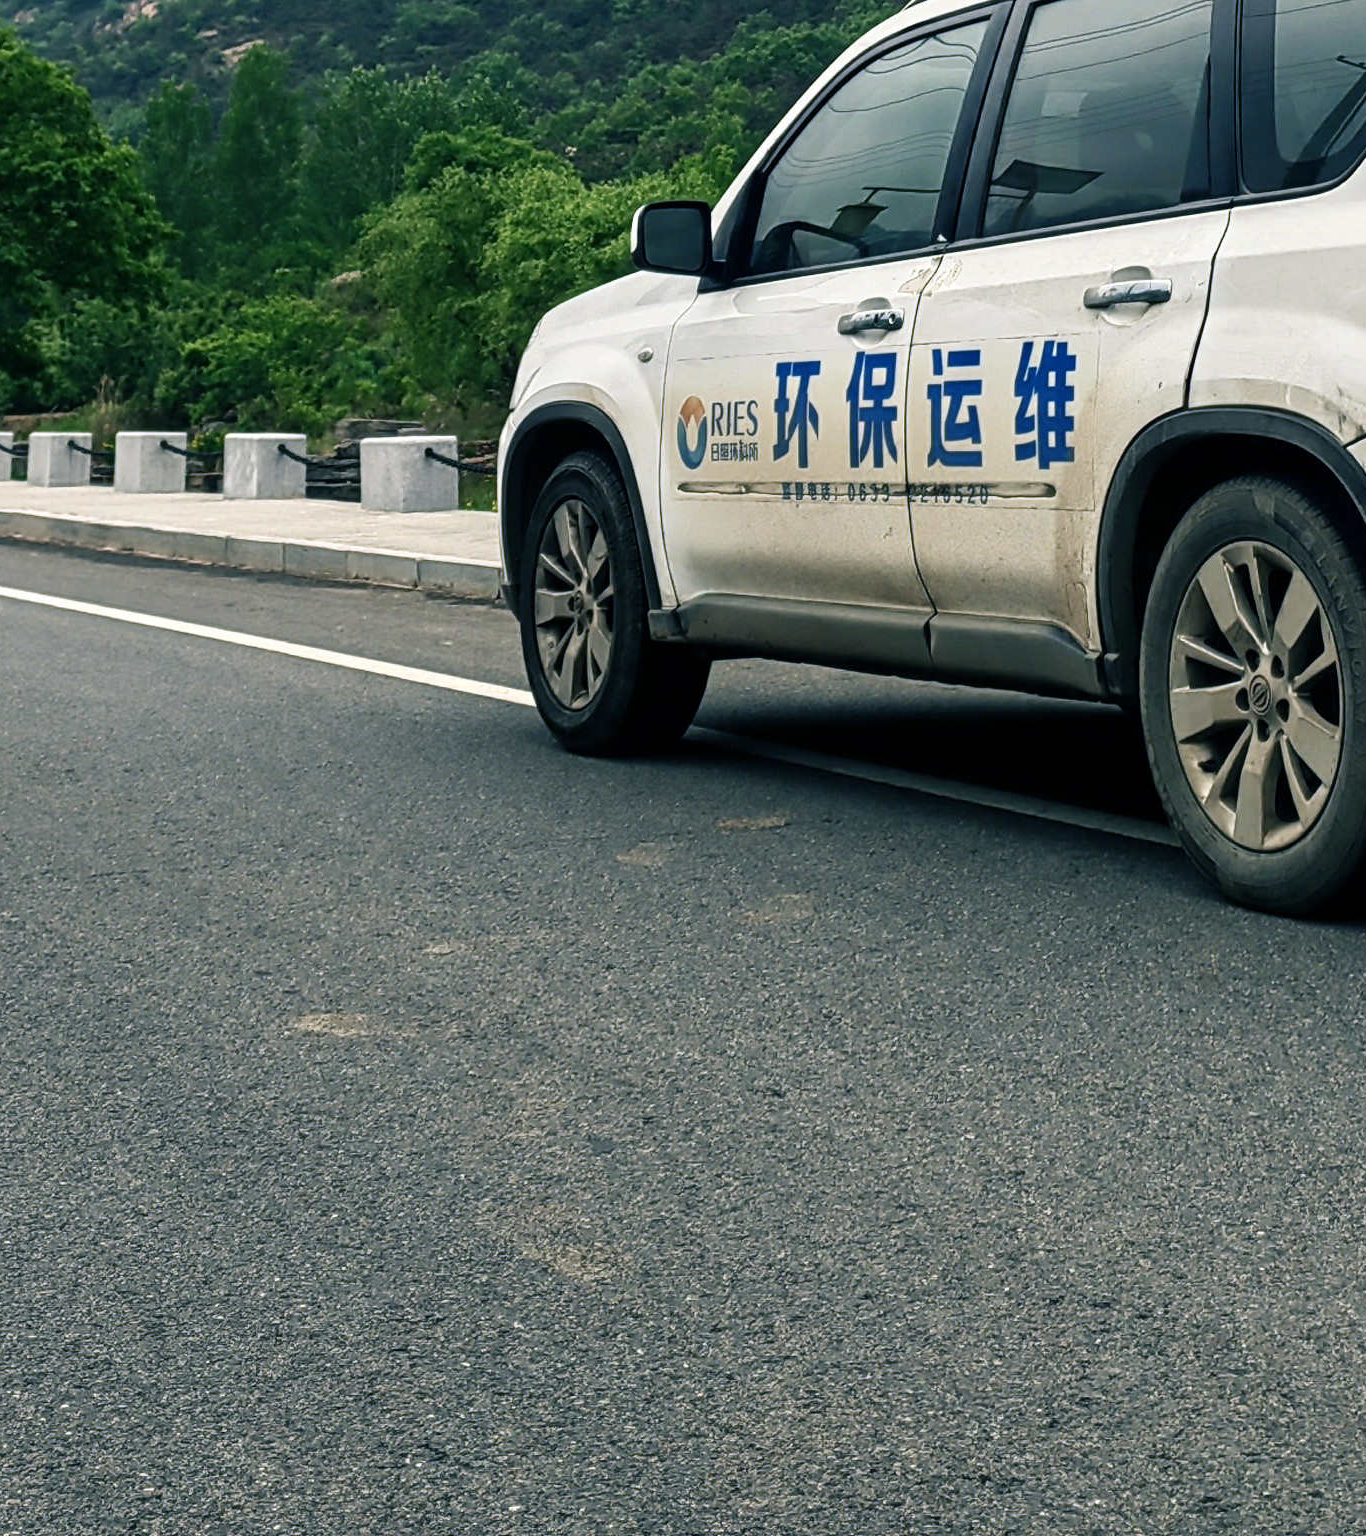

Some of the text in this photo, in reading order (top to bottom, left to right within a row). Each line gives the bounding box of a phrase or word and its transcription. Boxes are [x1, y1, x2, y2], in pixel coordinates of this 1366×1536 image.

[711, 400, 759, 437] RIES
[773, 340, 1077, 470] 环保运维
